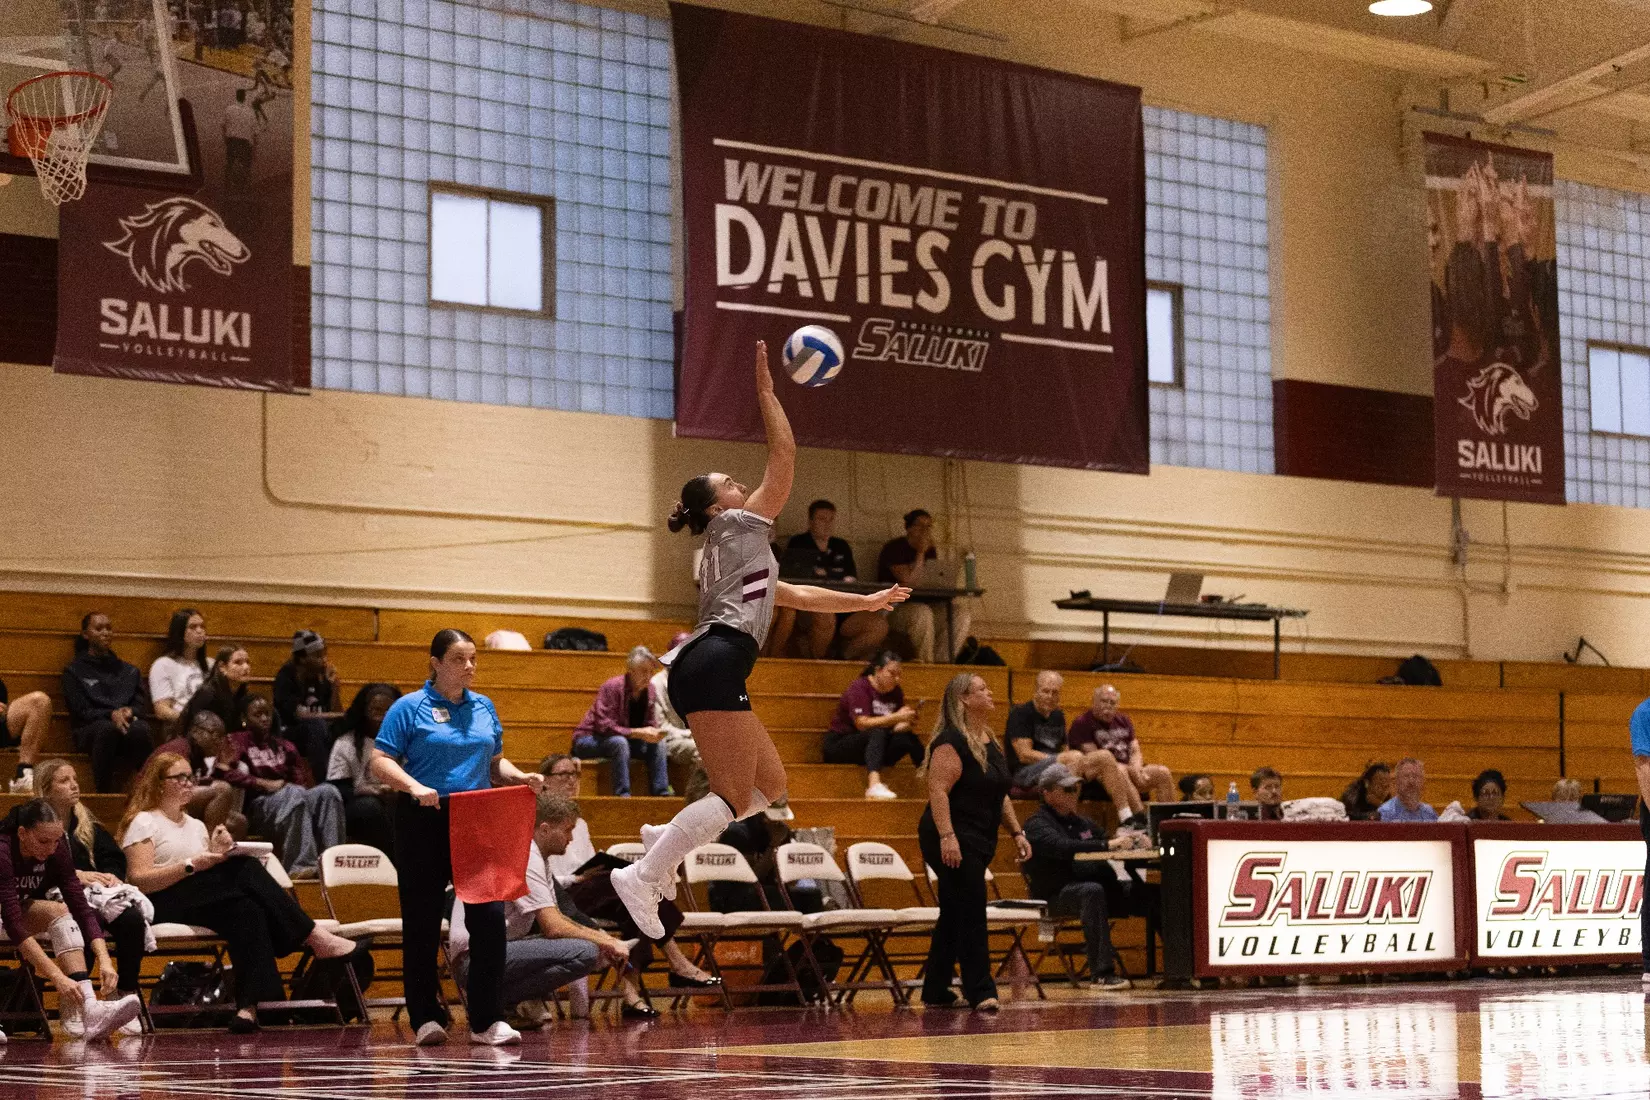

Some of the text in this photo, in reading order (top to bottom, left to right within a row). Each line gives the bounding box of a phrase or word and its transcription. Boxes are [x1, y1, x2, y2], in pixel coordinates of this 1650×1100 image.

[723, 158, 1037, 241] WELCOME TO
[715, 203, 1111, 333] DAVIES GYM
[100, 298, 251, 348] SALUKI
[851, 317, 990, 372] SALUKI
[122, 342, 228, 363] VOLLEYBALL
[1457, 440, 1542, 474] SALUKI
[1218, 851, 1433, 927] SALUKI
[1218, 932, 1436, 957] VOLLEYBALL
[1486, 927, 1642, 950] VOLLEYB
